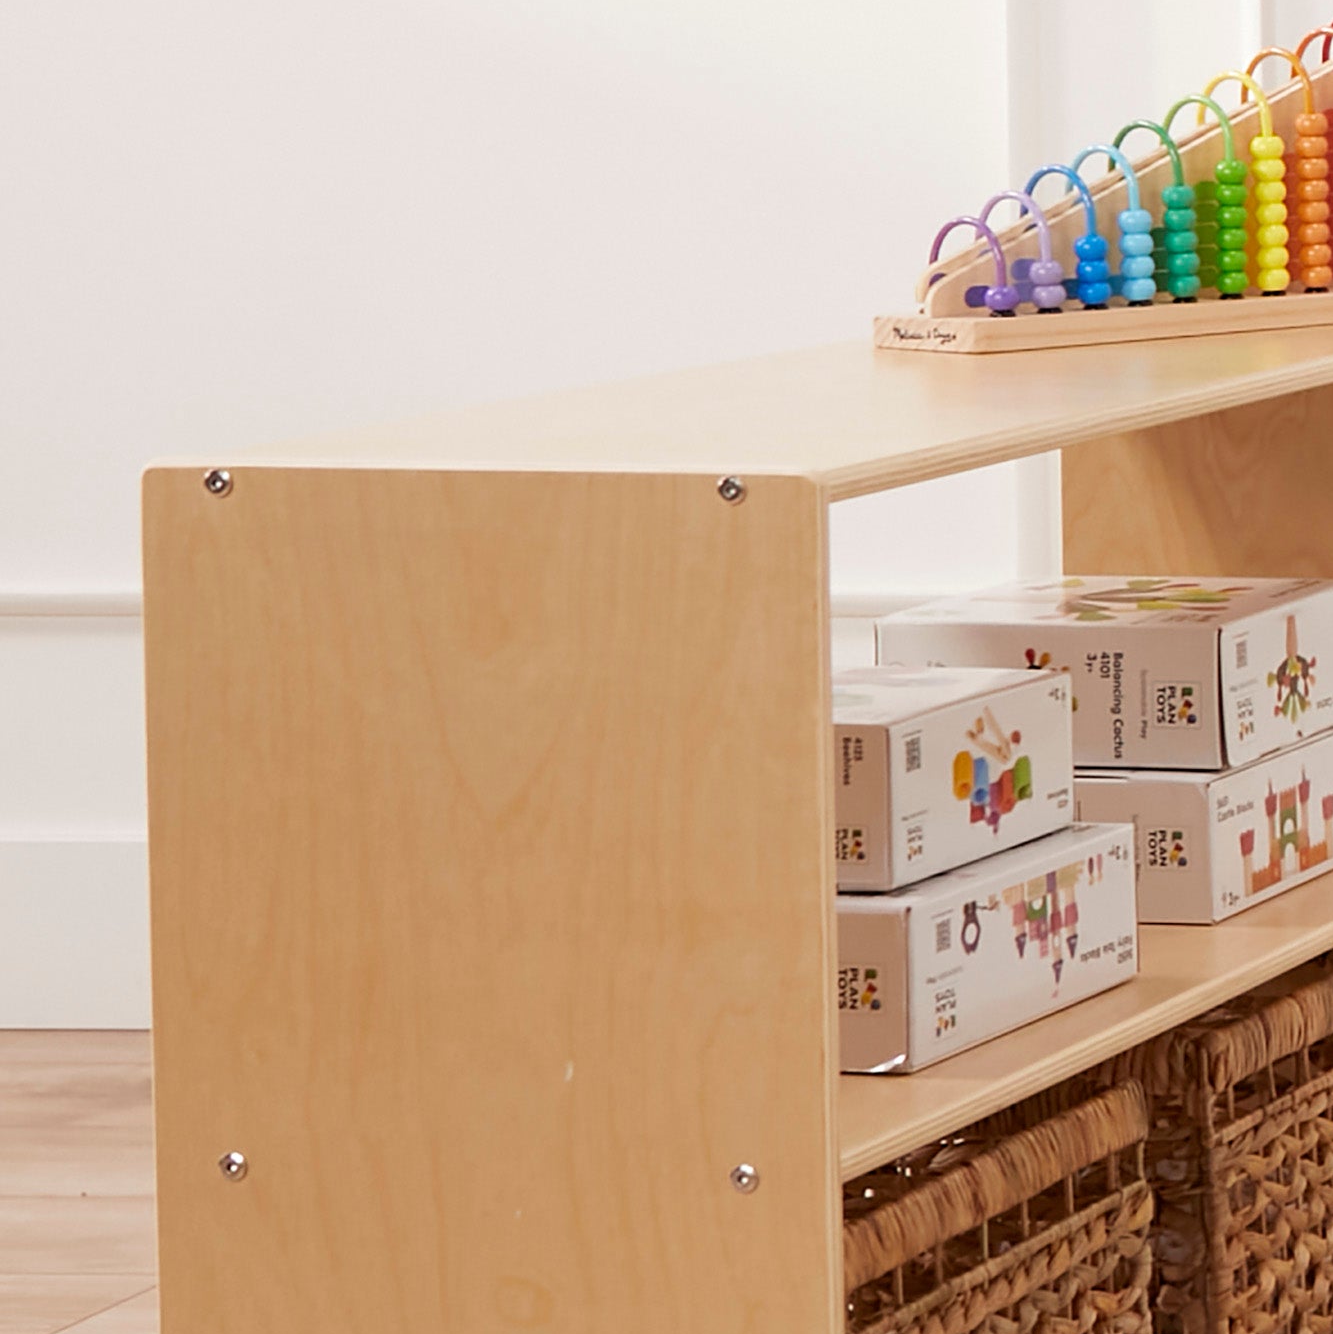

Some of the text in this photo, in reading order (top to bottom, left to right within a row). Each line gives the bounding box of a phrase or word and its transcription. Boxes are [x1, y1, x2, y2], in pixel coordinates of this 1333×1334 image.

[1100, 651, 1110, 678] 4101
[1111, 651, 1123, 759] Balancing Cactus
[1157, 686, 1166, 723] TOYS
[1167, 685, 1176, 724] PLAN
[841, 828, 850, 861] PLAN
[1148, 830, 1158, 867] TOYS
[1158, 829, 1167, 867] PLAN
[838, 968, 848, 1010] TOYS
[849, 967, 859, 1010] PLAN
